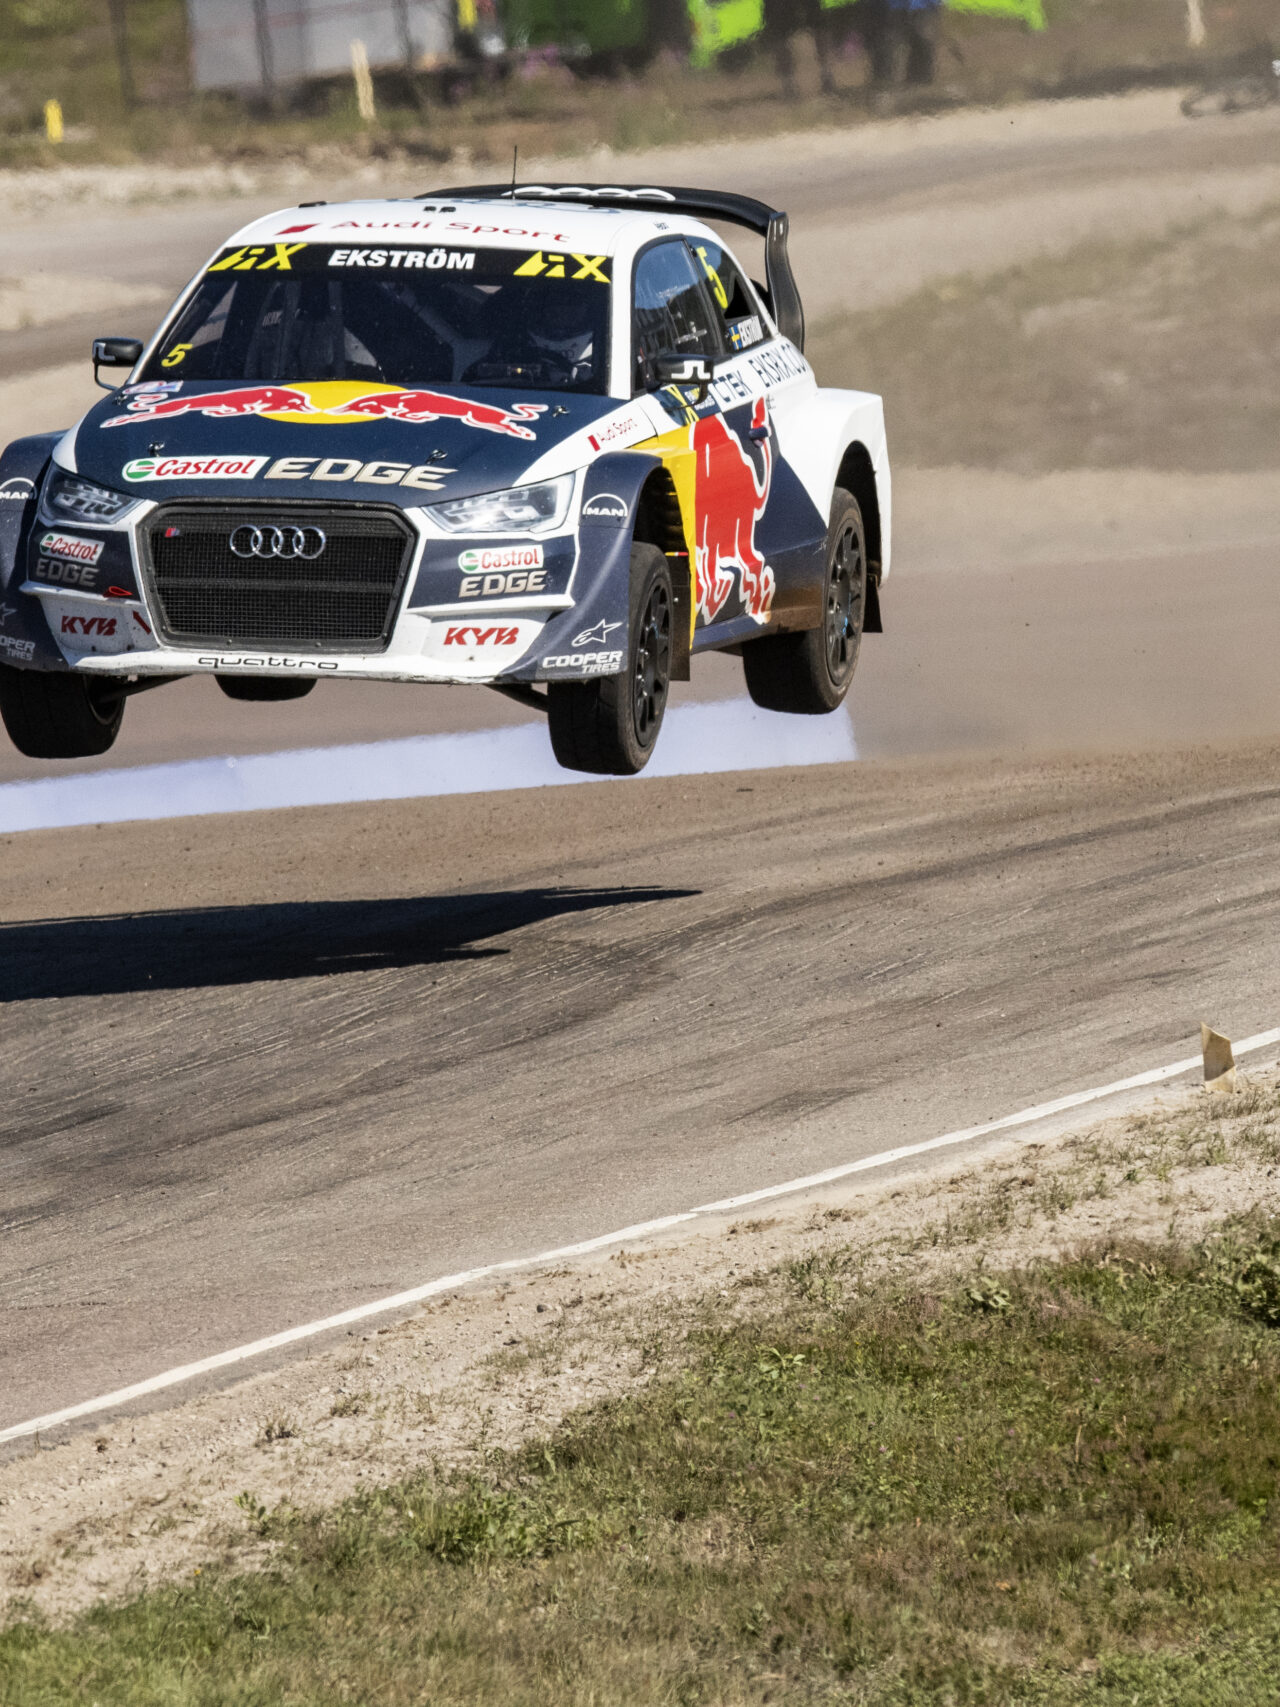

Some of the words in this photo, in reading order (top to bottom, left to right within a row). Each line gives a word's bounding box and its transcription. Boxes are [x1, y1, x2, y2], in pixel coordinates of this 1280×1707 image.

[330, 220, 431, 230] Audi
[445, 222, 570, 242] Sport
[328, 248, 476, 270] EKSTRÖM
[696, 246, 728, 309] 5
[161, 343, 193, 367] 5
[155, 458, 252, 477] Castrol
[264, 457, 459, 491] EDGE
[586, 507, 625, 517] MAN
[50, 537, 99, 561] Castrol
[481, 548, 540, 570] Castrol
[35, 558, 100, 587] EDGE
[459, 570, 548, 598] EDGE
[61, 615, 118, 636] KYB
[443, 626, 520, 646] KYB
[7, 648, 33, 661] TIRES
[198, 656, 339, 669] quattro
[542, 650, 624, 668] COOPER
[581, 663, 620, 674] TIRES
